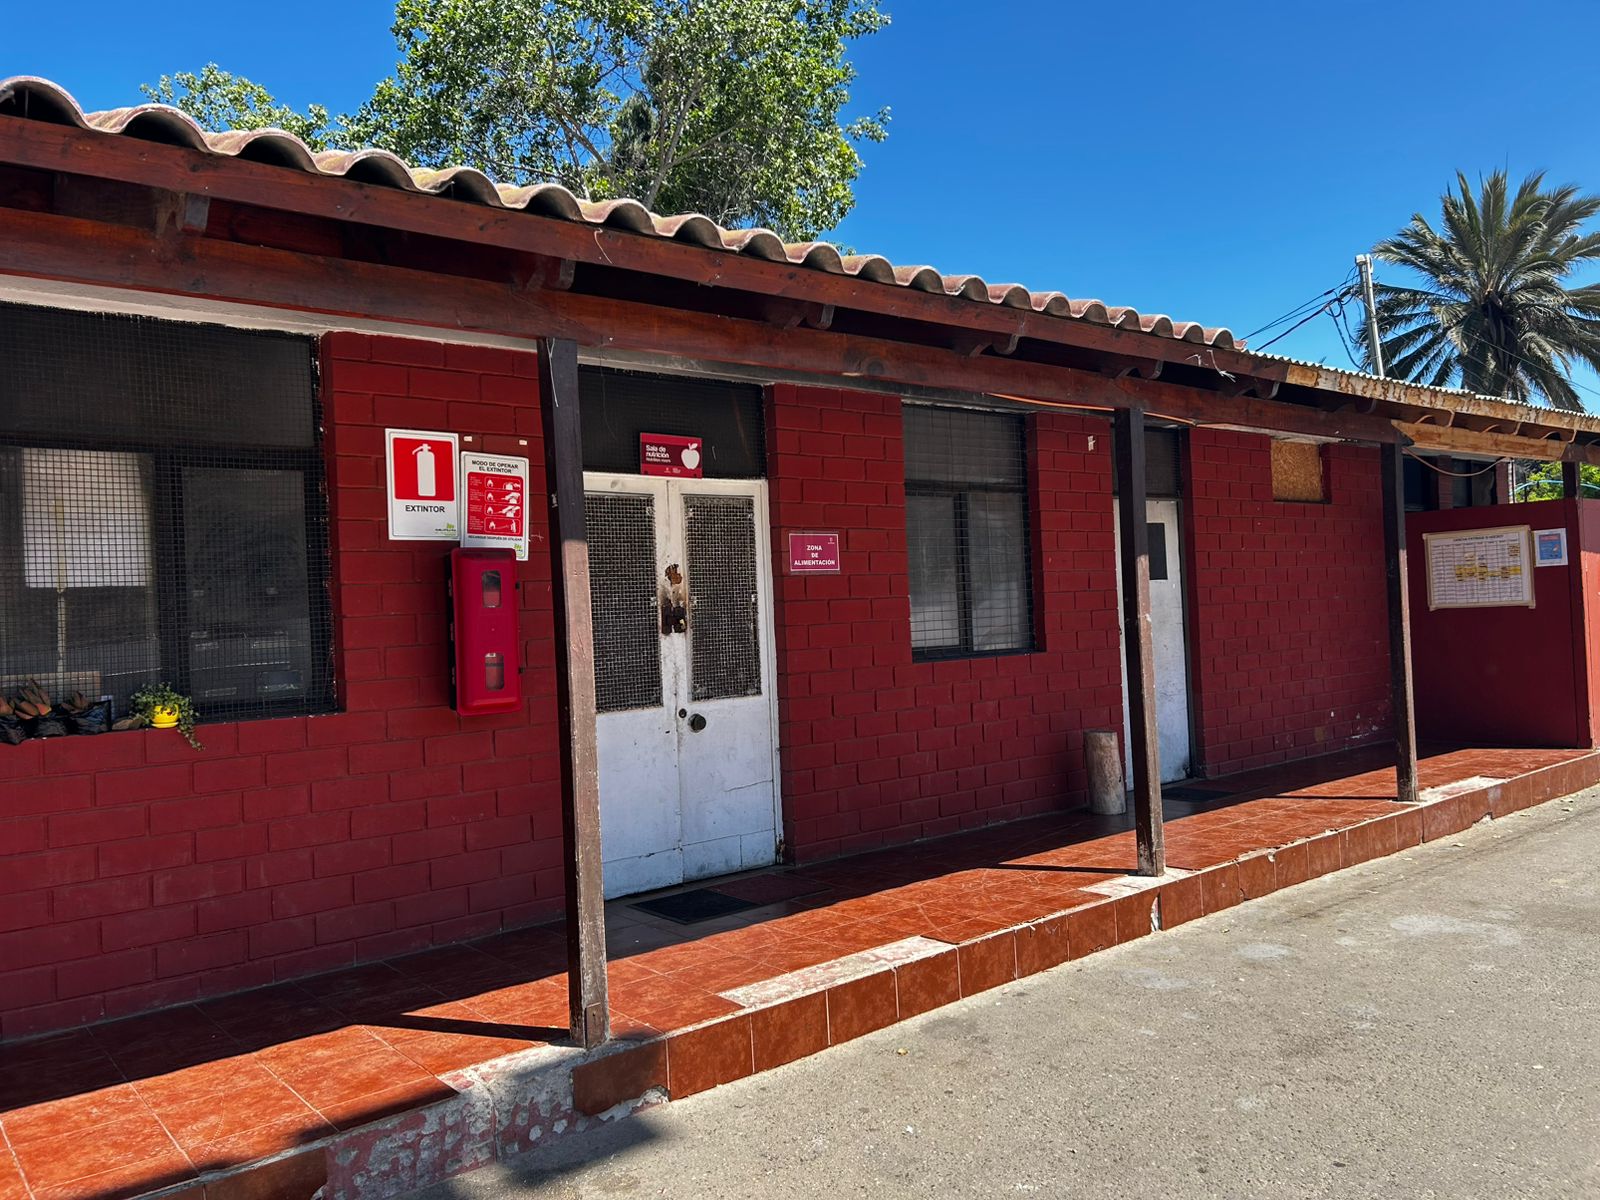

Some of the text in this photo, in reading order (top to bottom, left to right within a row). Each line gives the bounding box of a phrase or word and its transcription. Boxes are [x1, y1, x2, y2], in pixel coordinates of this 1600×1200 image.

[645, 444, 658, 452] Sala
[405, 504, 446, 513] EXTINTOR
[794, 558, 836, 566] ALIMENTACIÓN
